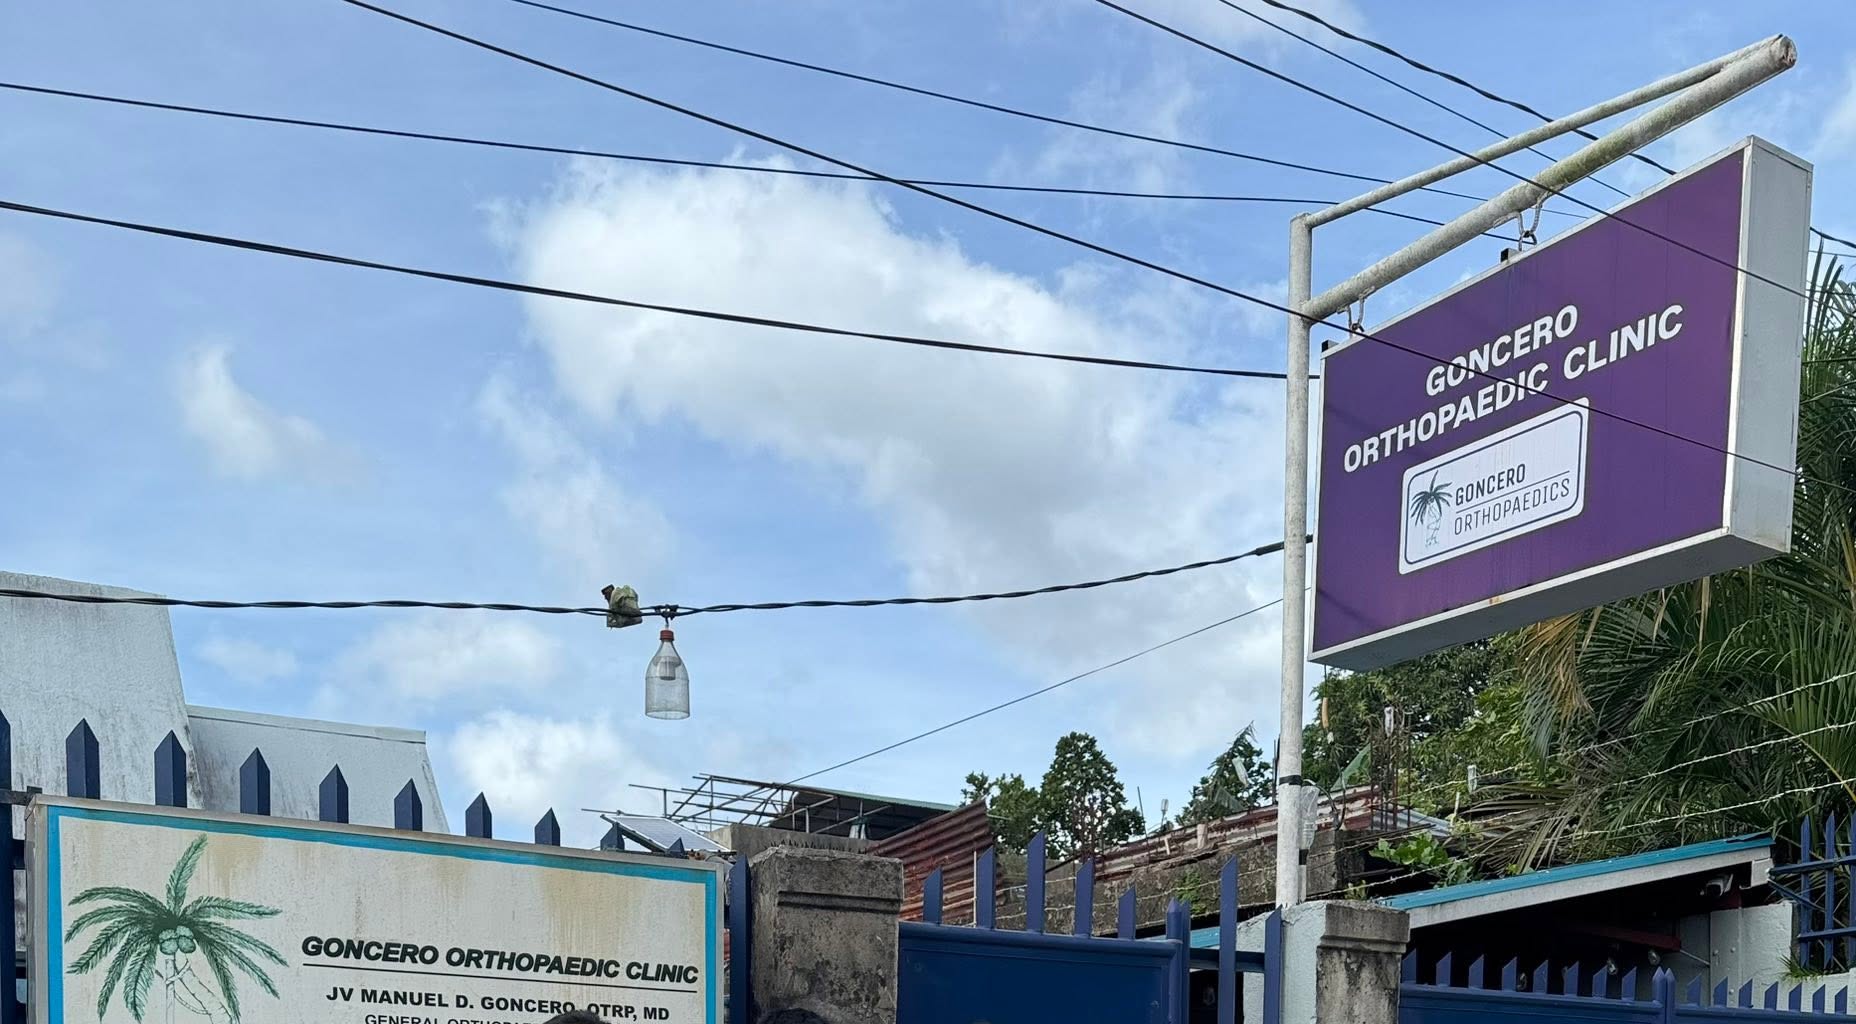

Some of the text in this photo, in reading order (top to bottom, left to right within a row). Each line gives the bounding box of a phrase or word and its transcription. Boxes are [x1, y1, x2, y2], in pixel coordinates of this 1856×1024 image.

[1425, 304, 1579, 397] GONCERO
[1343, 304, 1684, 473] ORTHOPAEDIC CLINIC
[1454, 478, 1570, 536] ORTHOPAEDICS
[1455, 463, 1526, 506] GONCERO
[301, 936, 699, 984] GONCERO ORTHOPAEDIC CLINIC
[326, 987, 354, 1002] JV
[361, 989, 449, 1007] MANUEL
[455, 995, 474, 1009] D.
[643, 1006, 670, 1020] MD
